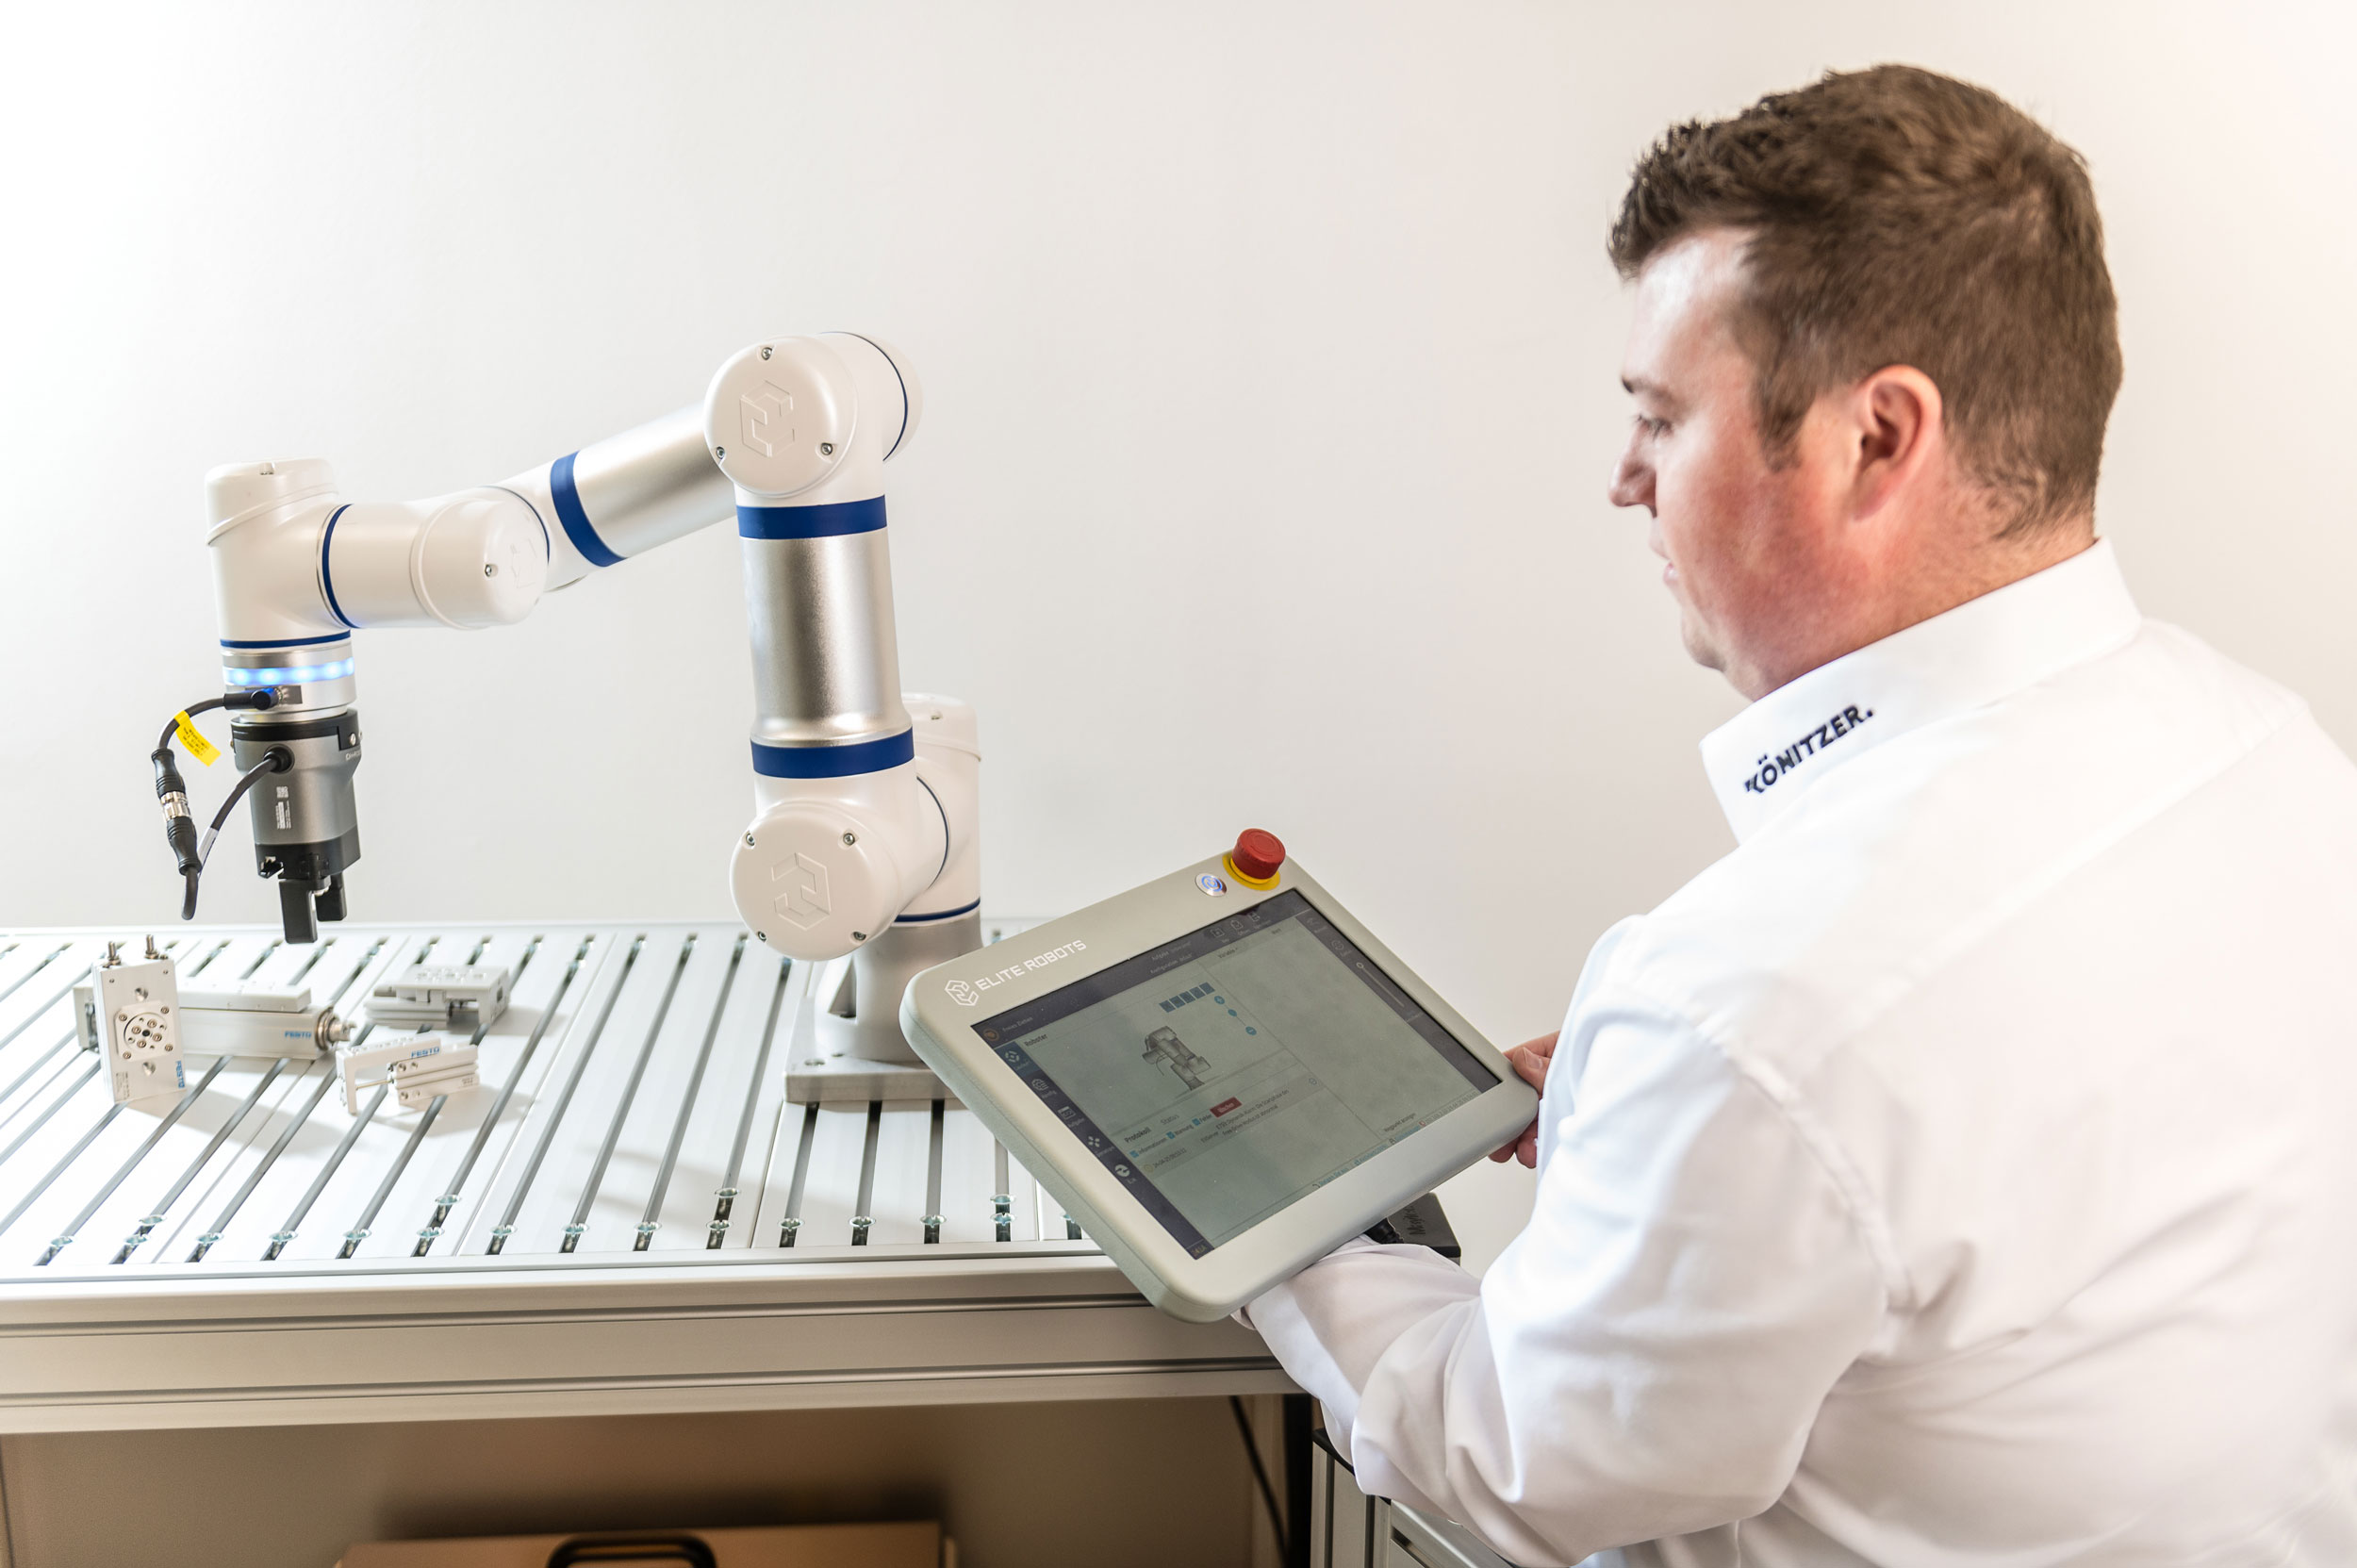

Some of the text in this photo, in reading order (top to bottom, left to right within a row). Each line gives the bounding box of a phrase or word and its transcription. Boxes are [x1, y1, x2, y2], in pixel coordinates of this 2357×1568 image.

[975, 939, 1087, 991] ELITE ROBOTS
[411, 1047, 440, 1058] FESTO
[176, 1061, 185, 1088] FESTO
[1159, 1113, 1179, 1125] Status
[1123, 1127, 1152, 1143] Protokoll
